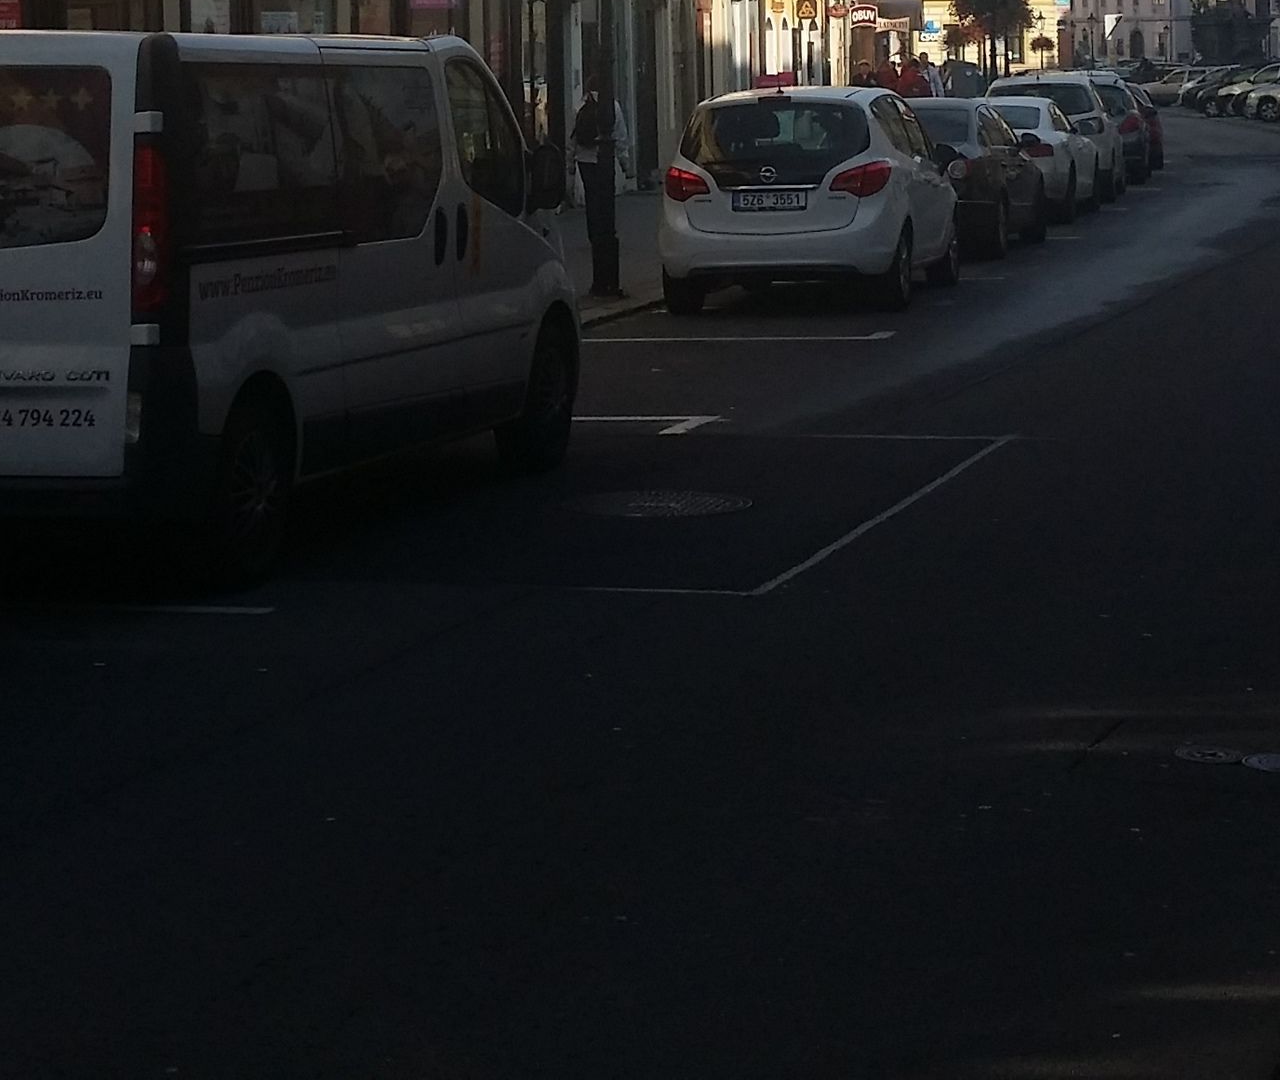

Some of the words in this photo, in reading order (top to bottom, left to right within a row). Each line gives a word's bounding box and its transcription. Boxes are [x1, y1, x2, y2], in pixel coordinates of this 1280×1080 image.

[852, 8, 876, 23] OBUV
[18, 408, 54, 427] 794
[59, 408, 96, 427] 224
